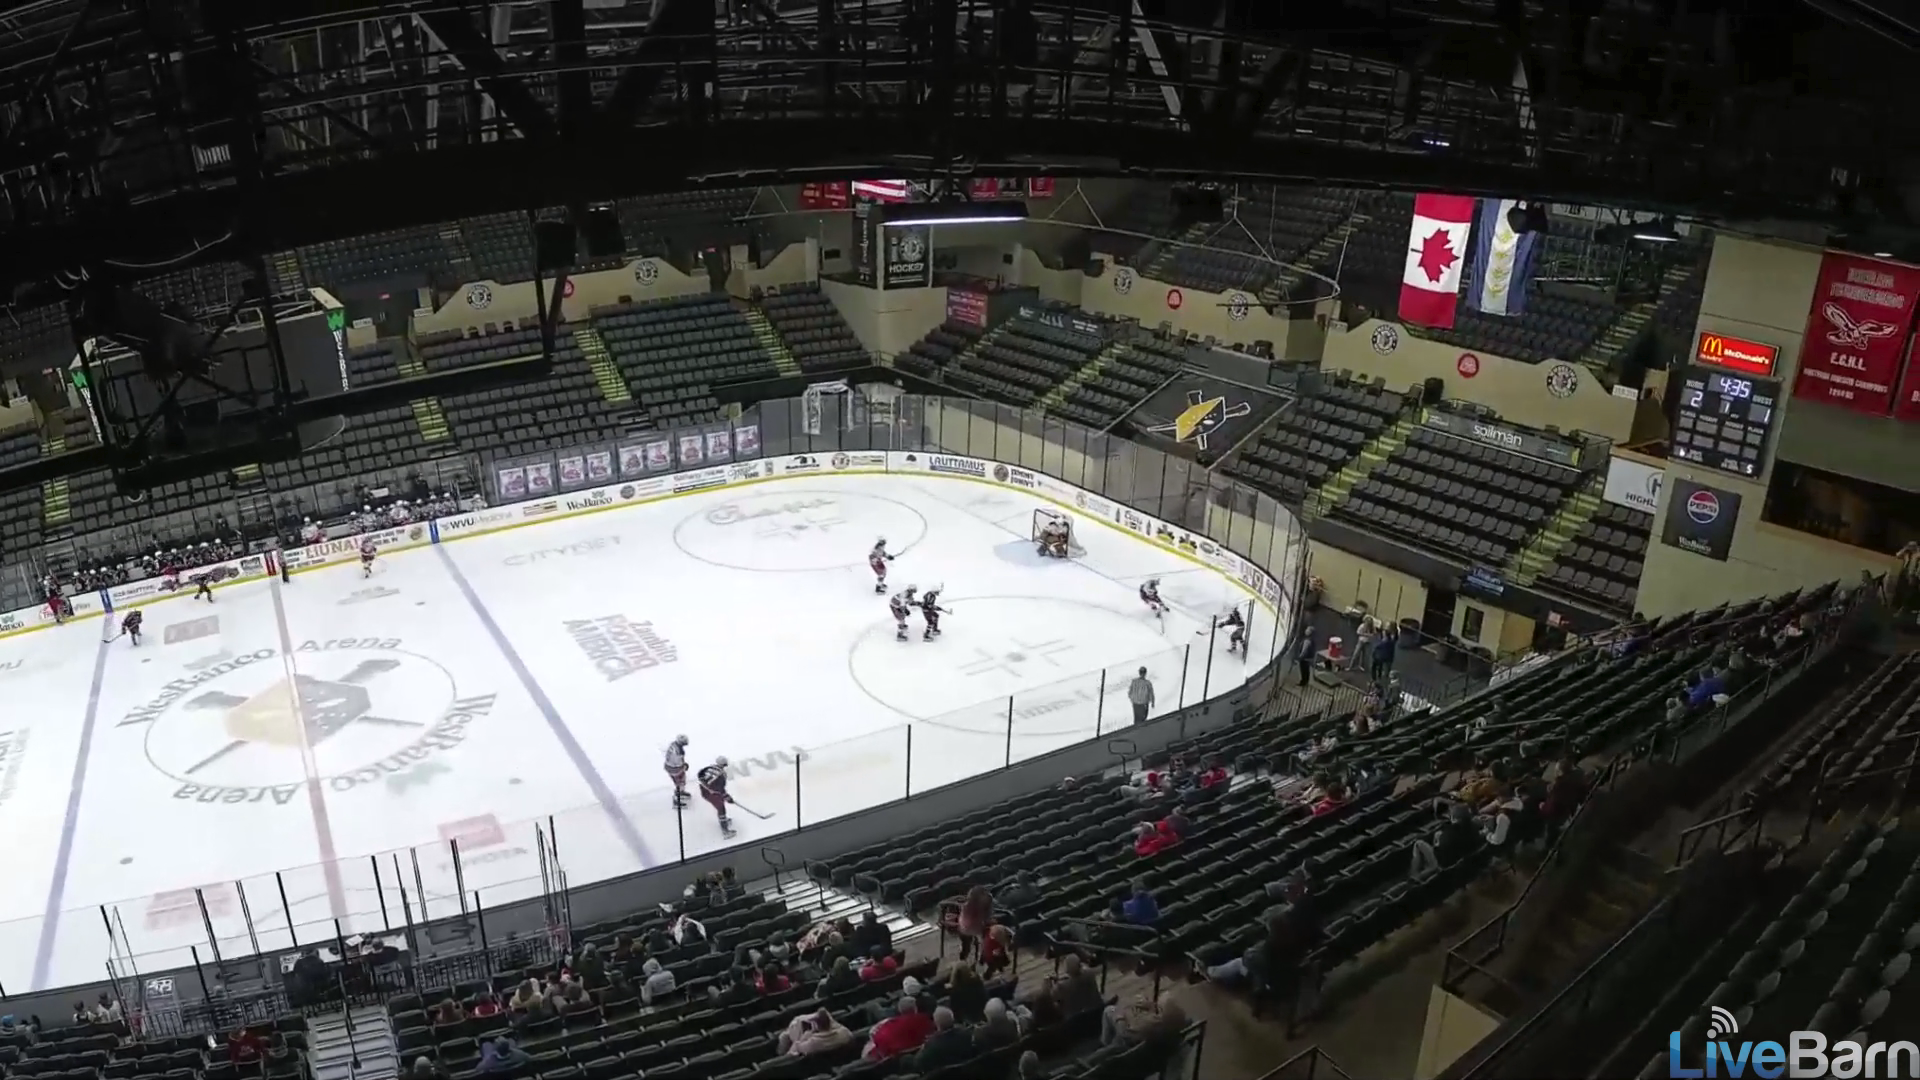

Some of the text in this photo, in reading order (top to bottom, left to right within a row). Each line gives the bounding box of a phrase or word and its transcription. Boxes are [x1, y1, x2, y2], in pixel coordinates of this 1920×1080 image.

[889, 263, 925, 273] HOCKEY
[1724, 348, 1770, 365] McDonald's
[1720, 377, 1752, 398] 4:35
[1690, 391, 1704, 408] 2
[1765, 409, 1771, 423] 1
[928, 456, 986, 473] LAUTTAMUS
[566, 496, 613, 512] WesBanco
[1689, 501, 1718, 514] PEPSI
[450, 518, 475, 530] WVU
[115, 636, 403, 729] WesBanco Arena
[171, 691, 498, 806] WesBanco Arena
